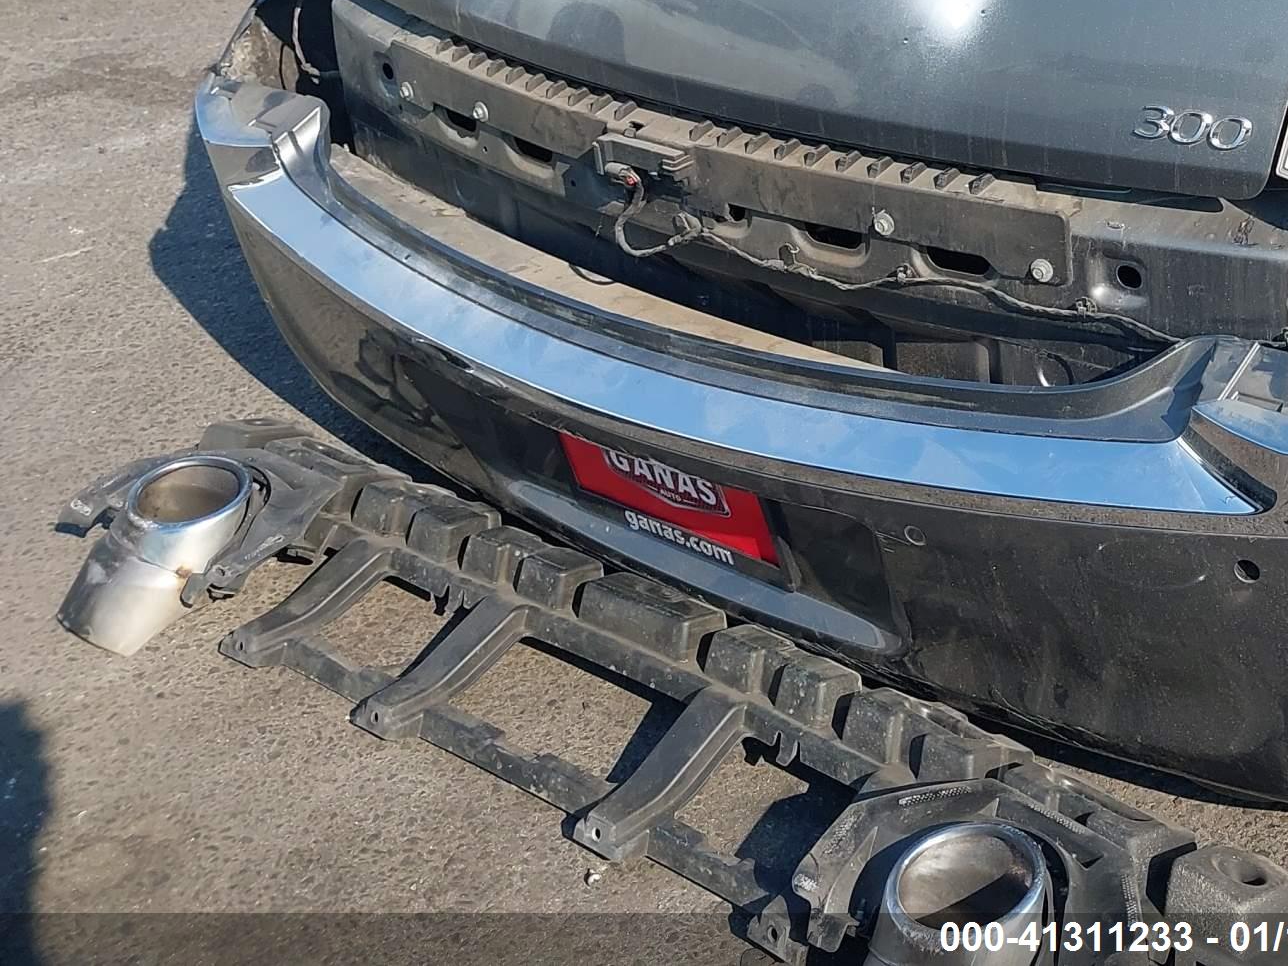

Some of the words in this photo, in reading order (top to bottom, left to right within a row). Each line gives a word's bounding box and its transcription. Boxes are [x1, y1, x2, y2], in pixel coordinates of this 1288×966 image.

[1132, 105, 1253, 150] 300
[609, 449, 717, 506] GANAS
[660, 489, 682, 502] AUTO
[624, 510, 734, 565] ganas.com
